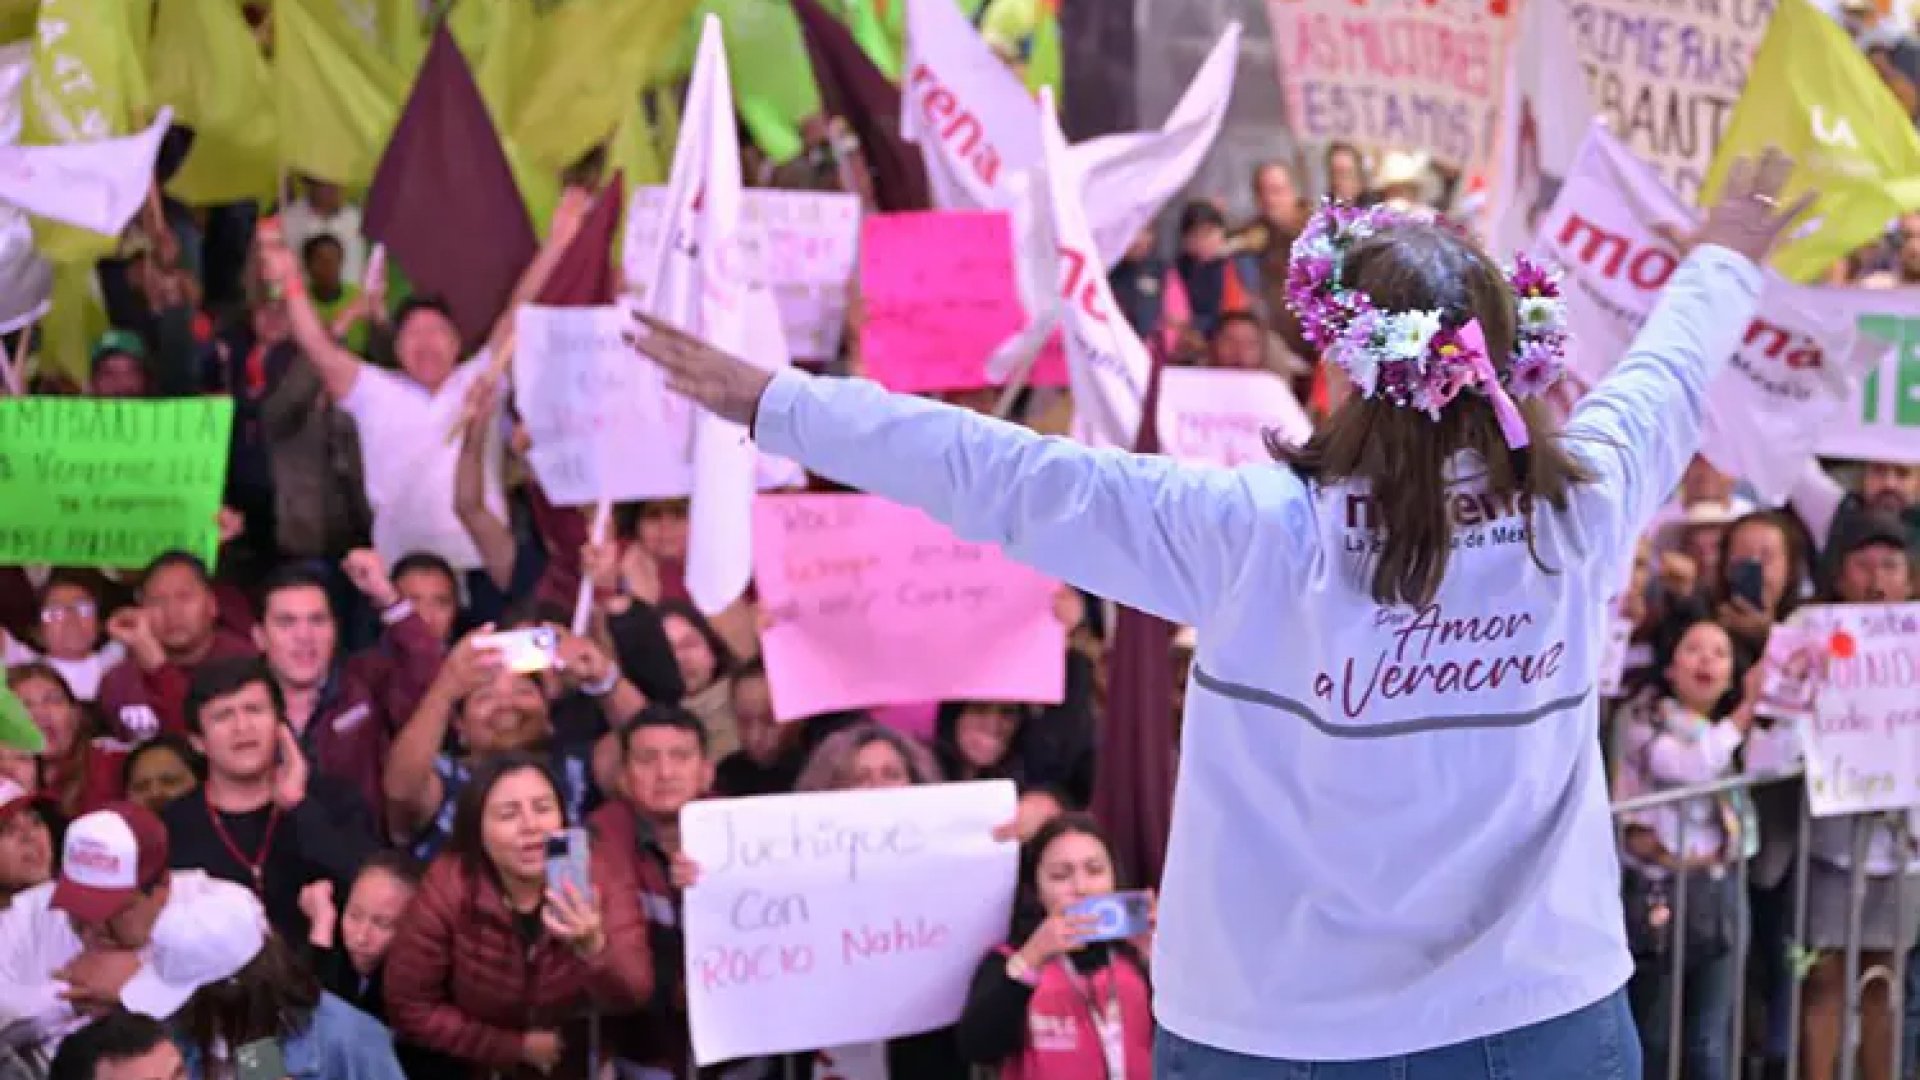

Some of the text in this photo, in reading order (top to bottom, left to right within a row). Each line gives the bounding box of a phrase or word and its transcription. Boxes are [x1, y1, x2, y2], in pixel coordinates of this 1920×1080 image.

[1346, 492, 1533, 528] mena
[1393, 603, 1532, 661] Amor
[1314, 641, 1565, 719] a Veracruz
